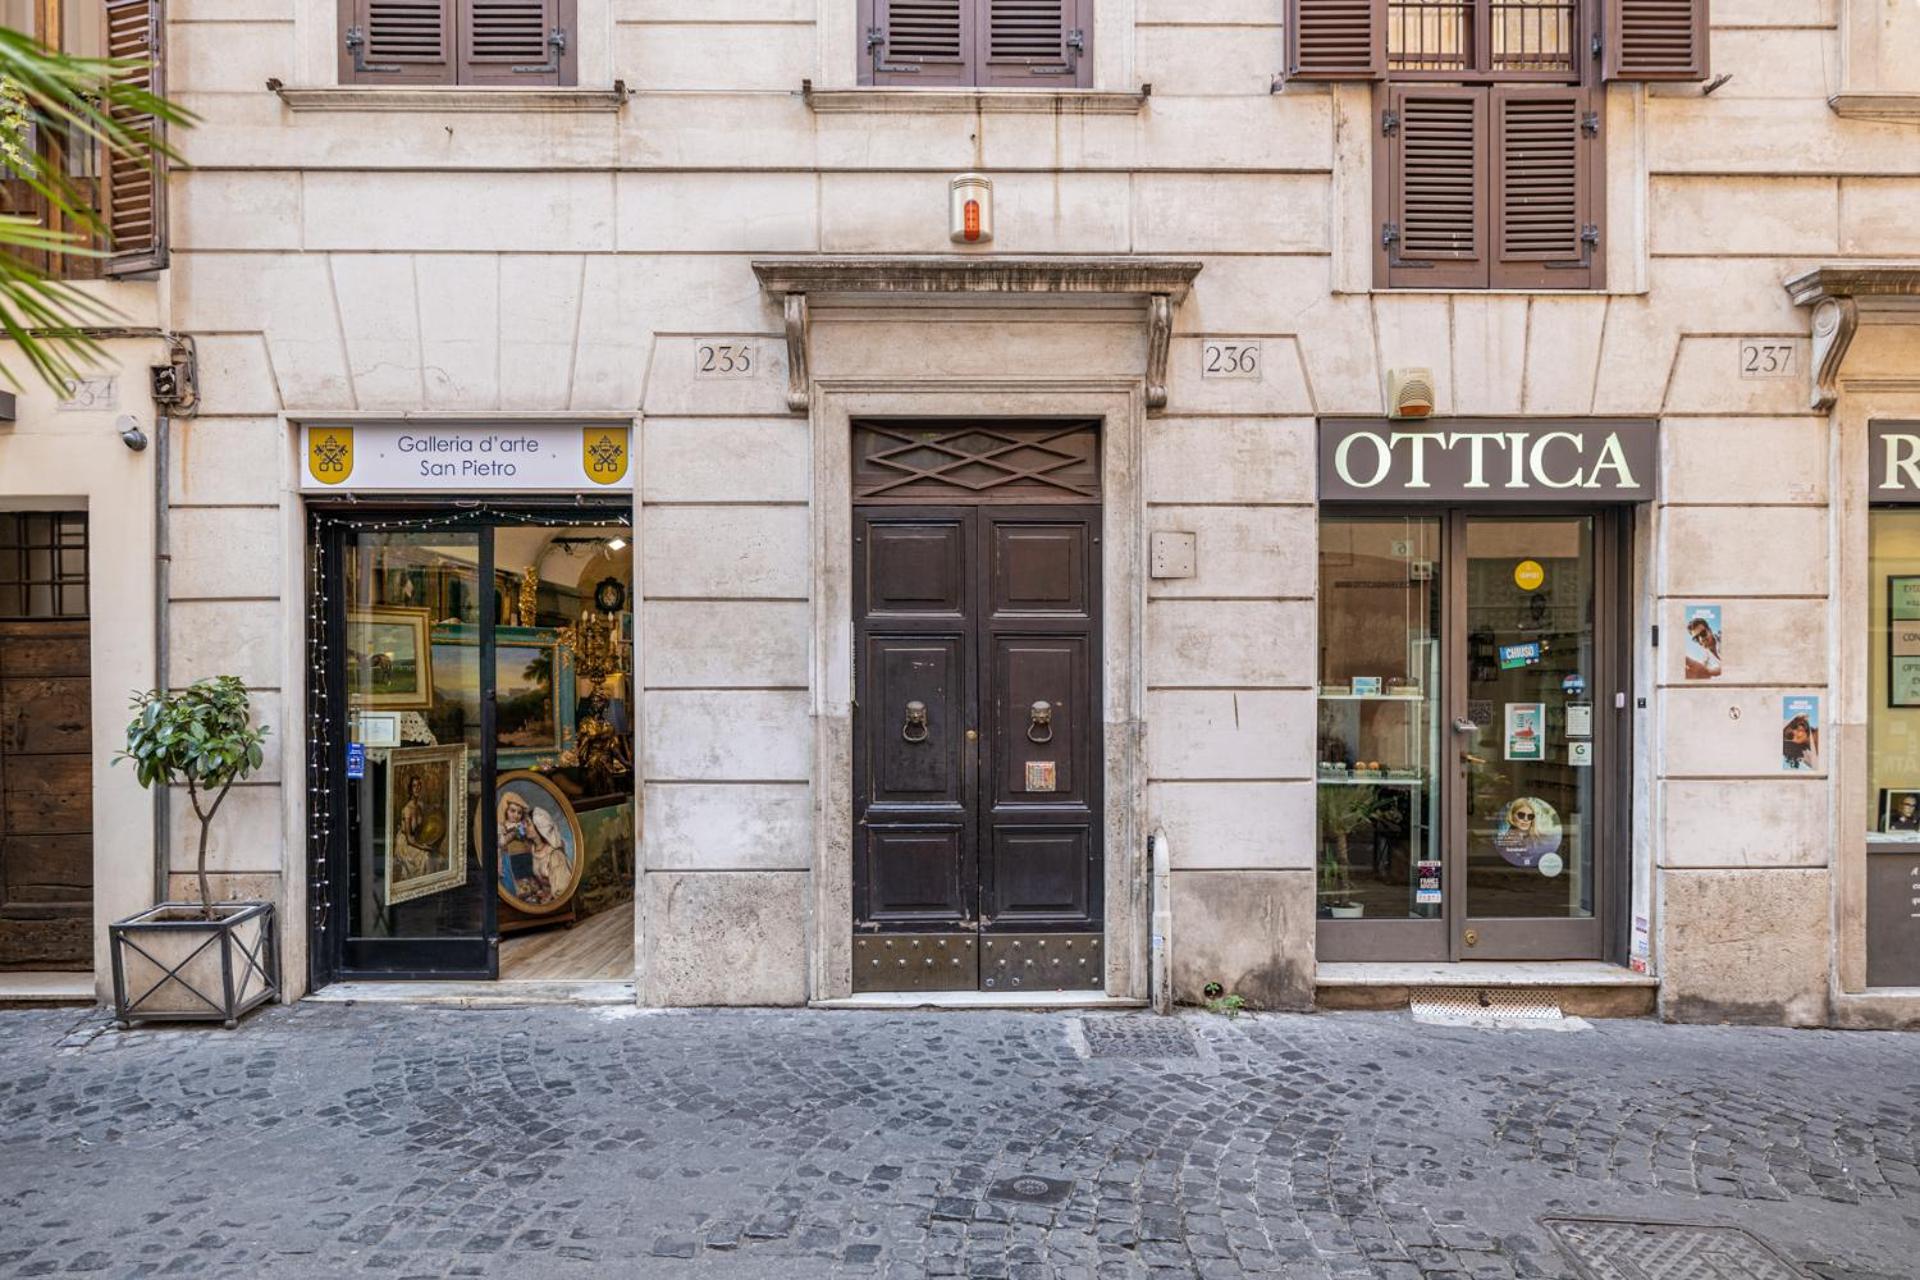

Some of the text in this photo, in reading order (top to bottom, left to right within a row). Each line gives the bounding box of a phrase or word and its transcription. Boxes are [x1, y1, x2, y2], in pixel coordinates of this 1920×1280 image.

[699, 345, 751, 372] 235
[1206, 346, 1258, 373] 236
[1743, 345, 1792, 373] 237
[397, 435, 539, 453] Galleria d'arte
[420, 459, 517, 477] San Pietro
[1334, 431, 1641, 488] OTTICA
